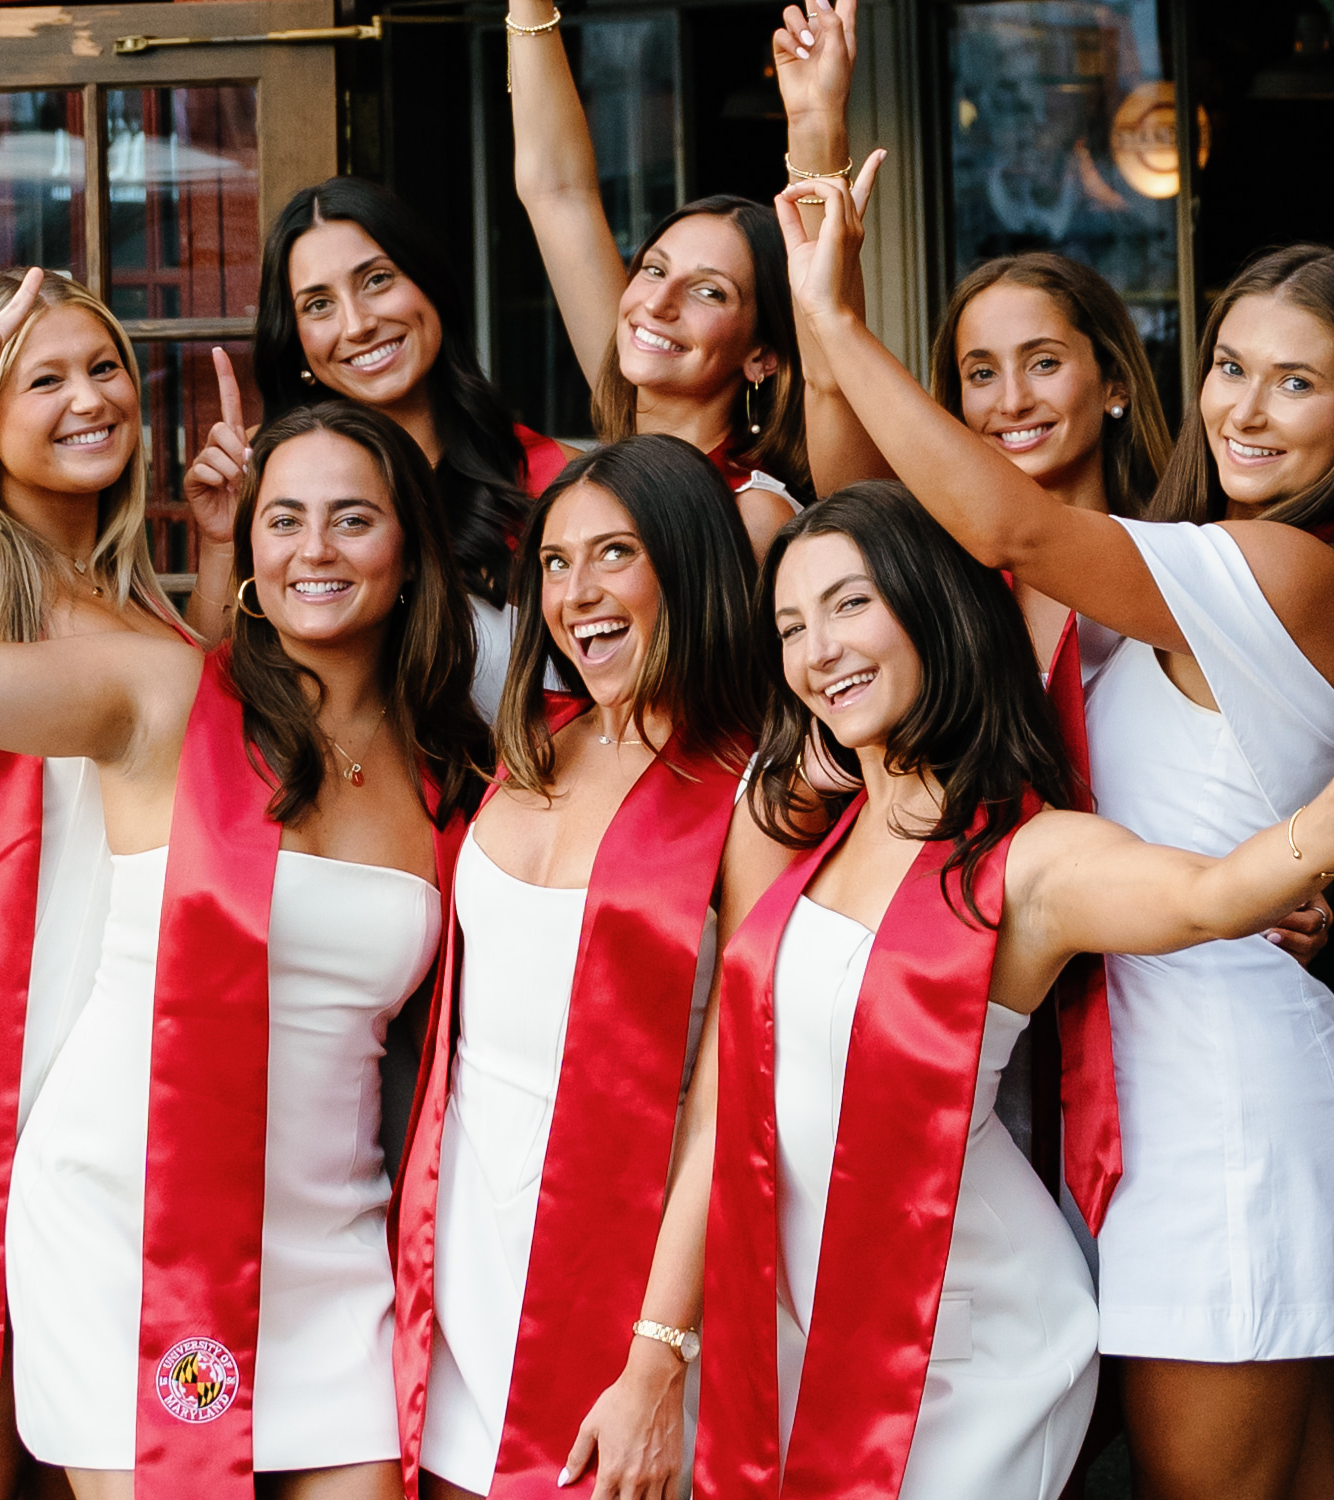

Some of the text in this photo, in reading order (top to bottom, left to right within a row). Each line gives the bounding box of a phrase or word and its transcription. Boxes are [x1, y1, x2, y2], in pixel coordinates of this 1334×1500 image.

[164, 1341, 233, 1368] UNIVERSITY OF
[163, 1393, 230, 1420] MARYLAND
